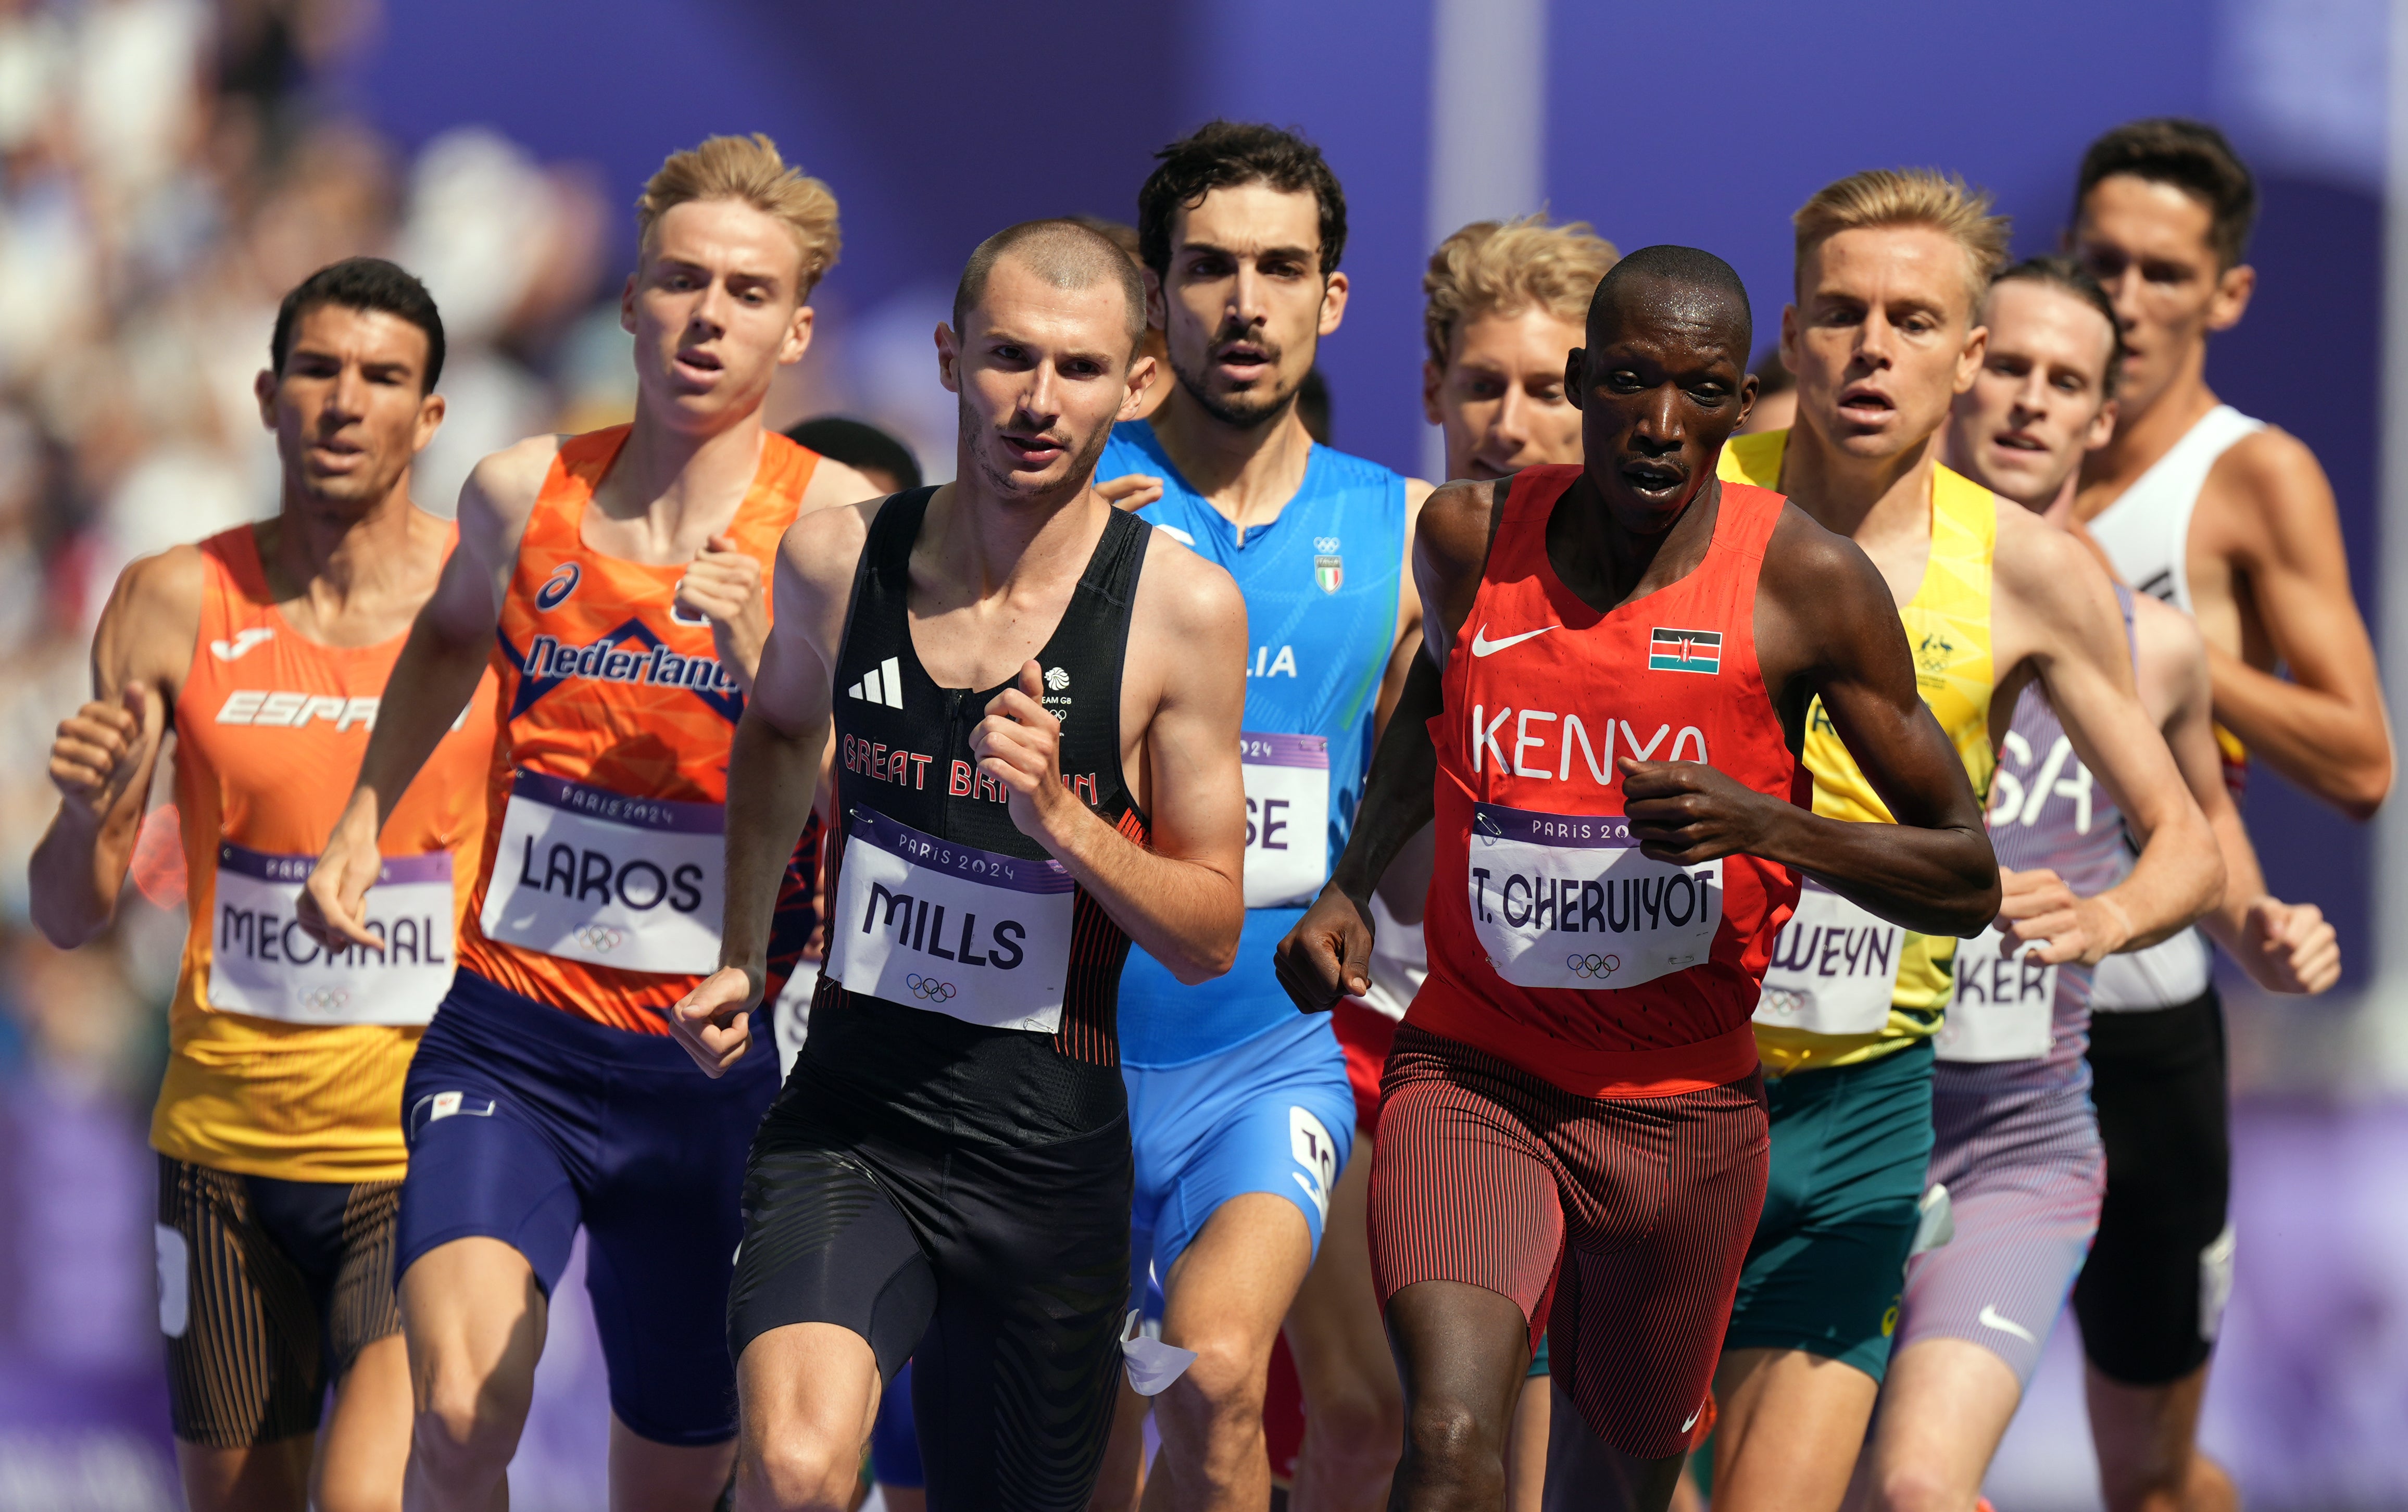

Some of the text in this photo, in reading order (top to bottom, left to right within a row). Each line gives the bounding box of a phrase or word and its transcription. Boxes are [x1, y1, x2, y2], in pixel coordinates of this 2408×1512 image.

[843, 733, 933, 790] GREAT
[1473, 704, 1708, 785] KENYA
[561, 786, 674, 824] PARIS 2024
[1533, 820, 1591, 839] PARIS
[519, 834, 703, 914] LAROS
[899, 834, 1014, 880] PARIS 2024
[862, 881, 1026, 970] MILLS
[1473, 867, 1714, 933] T. CHERUIYOT
